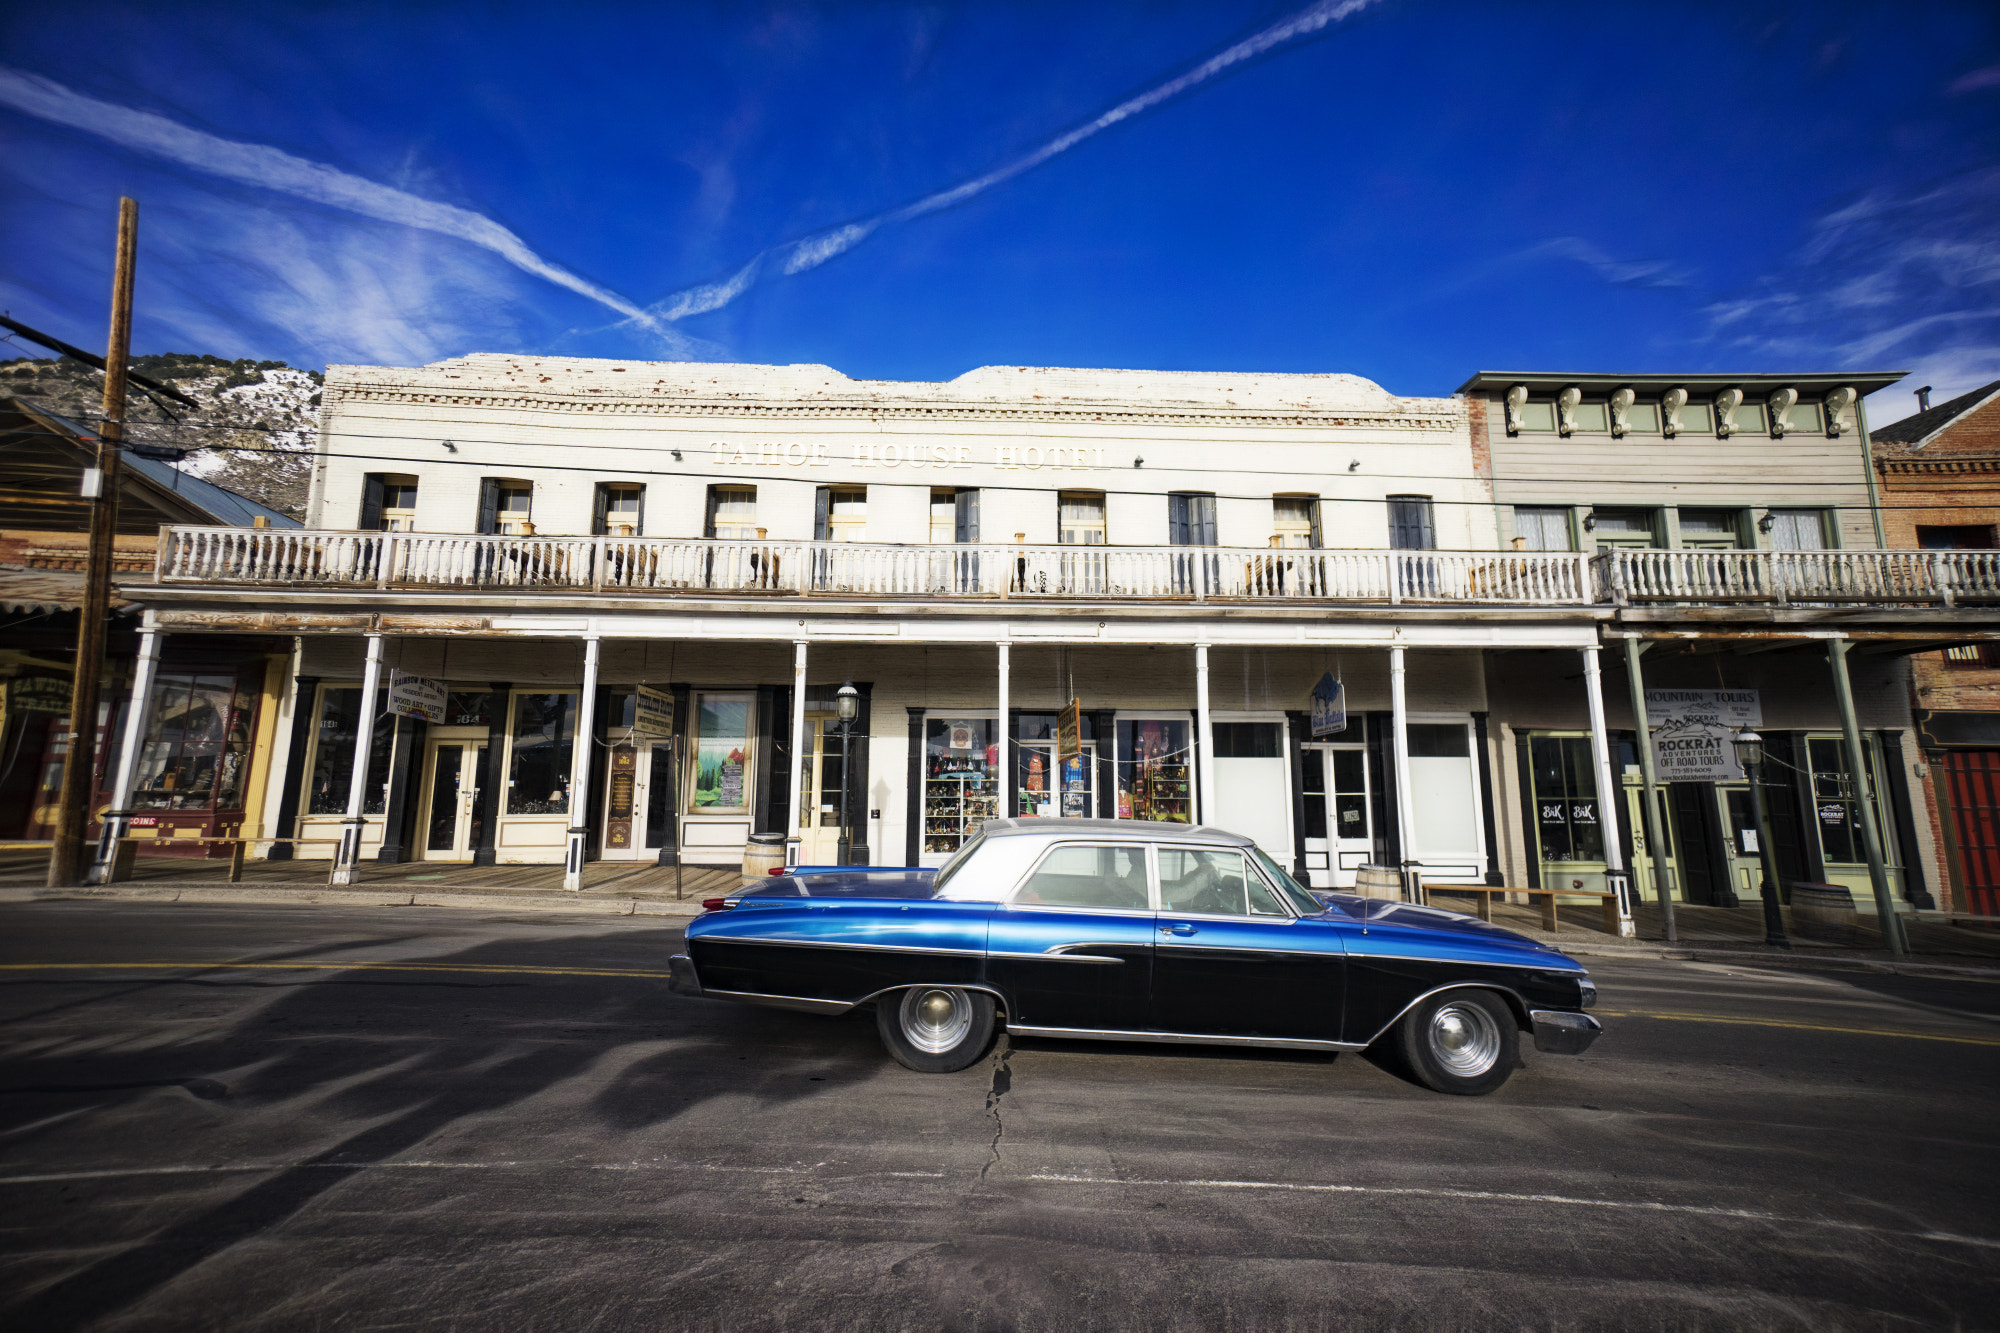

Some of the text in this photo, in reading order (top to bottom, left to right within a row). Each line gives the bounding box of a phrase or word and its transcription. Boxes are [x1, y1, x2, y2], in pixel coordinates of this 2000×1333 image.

[708, 440, 1112, 471] TAHOE HOUSE HOTEL
[394, 676, 446, 698] RAINBOW METAL ART
[393, 695, 444, 713] WOOD ART GIFTS
[1714, 692, 1755, 703] TOURS
[1658, 737, 1723, 752] ROCKRAT
[1660, 755, 1725, 767] OFF ROAD TOURS
[1662, 749, 1722, 758] ADVENTURES
